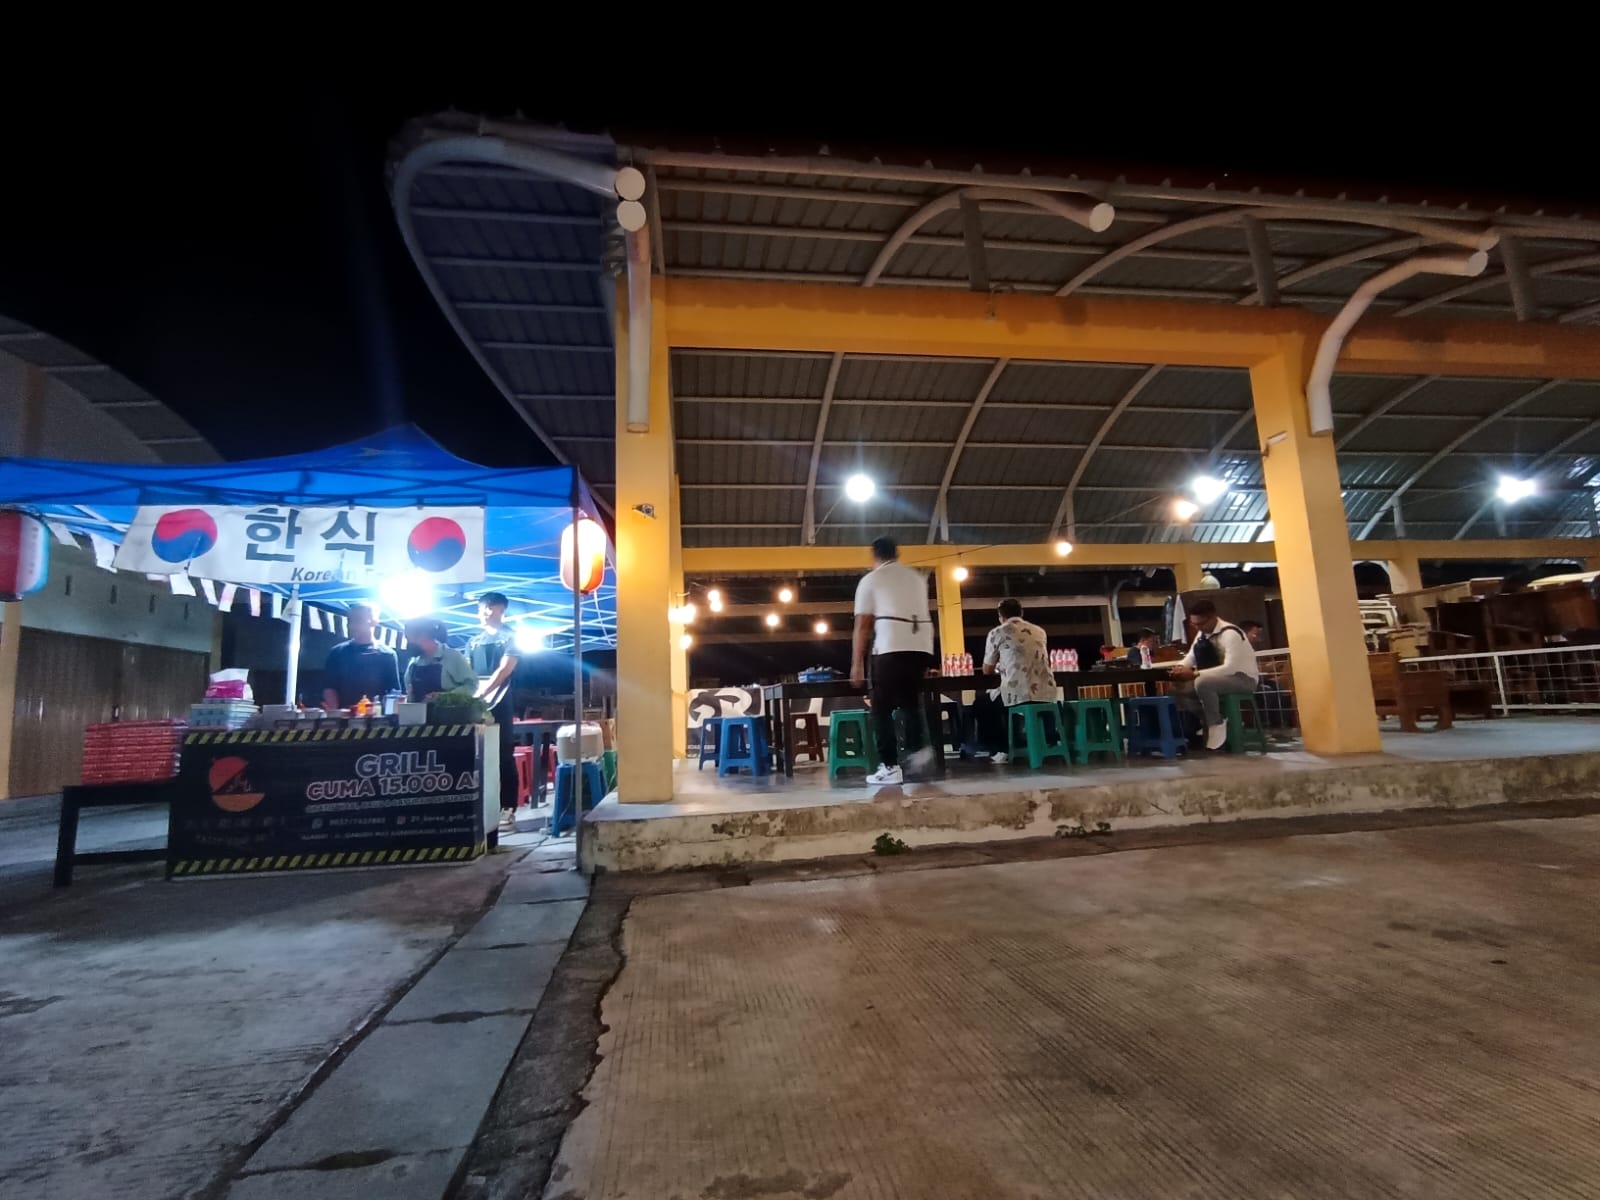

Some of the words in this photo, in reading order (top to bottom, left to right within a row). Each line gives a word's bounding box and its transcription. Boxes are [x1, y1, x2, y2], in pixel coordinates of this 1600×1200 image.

[244, 507, 378, 565] 한식
[356, 751, 446, 777] GRILL
[307, 780, 375, 800] CUMA
[379, 773, 453, 795] 15.000
